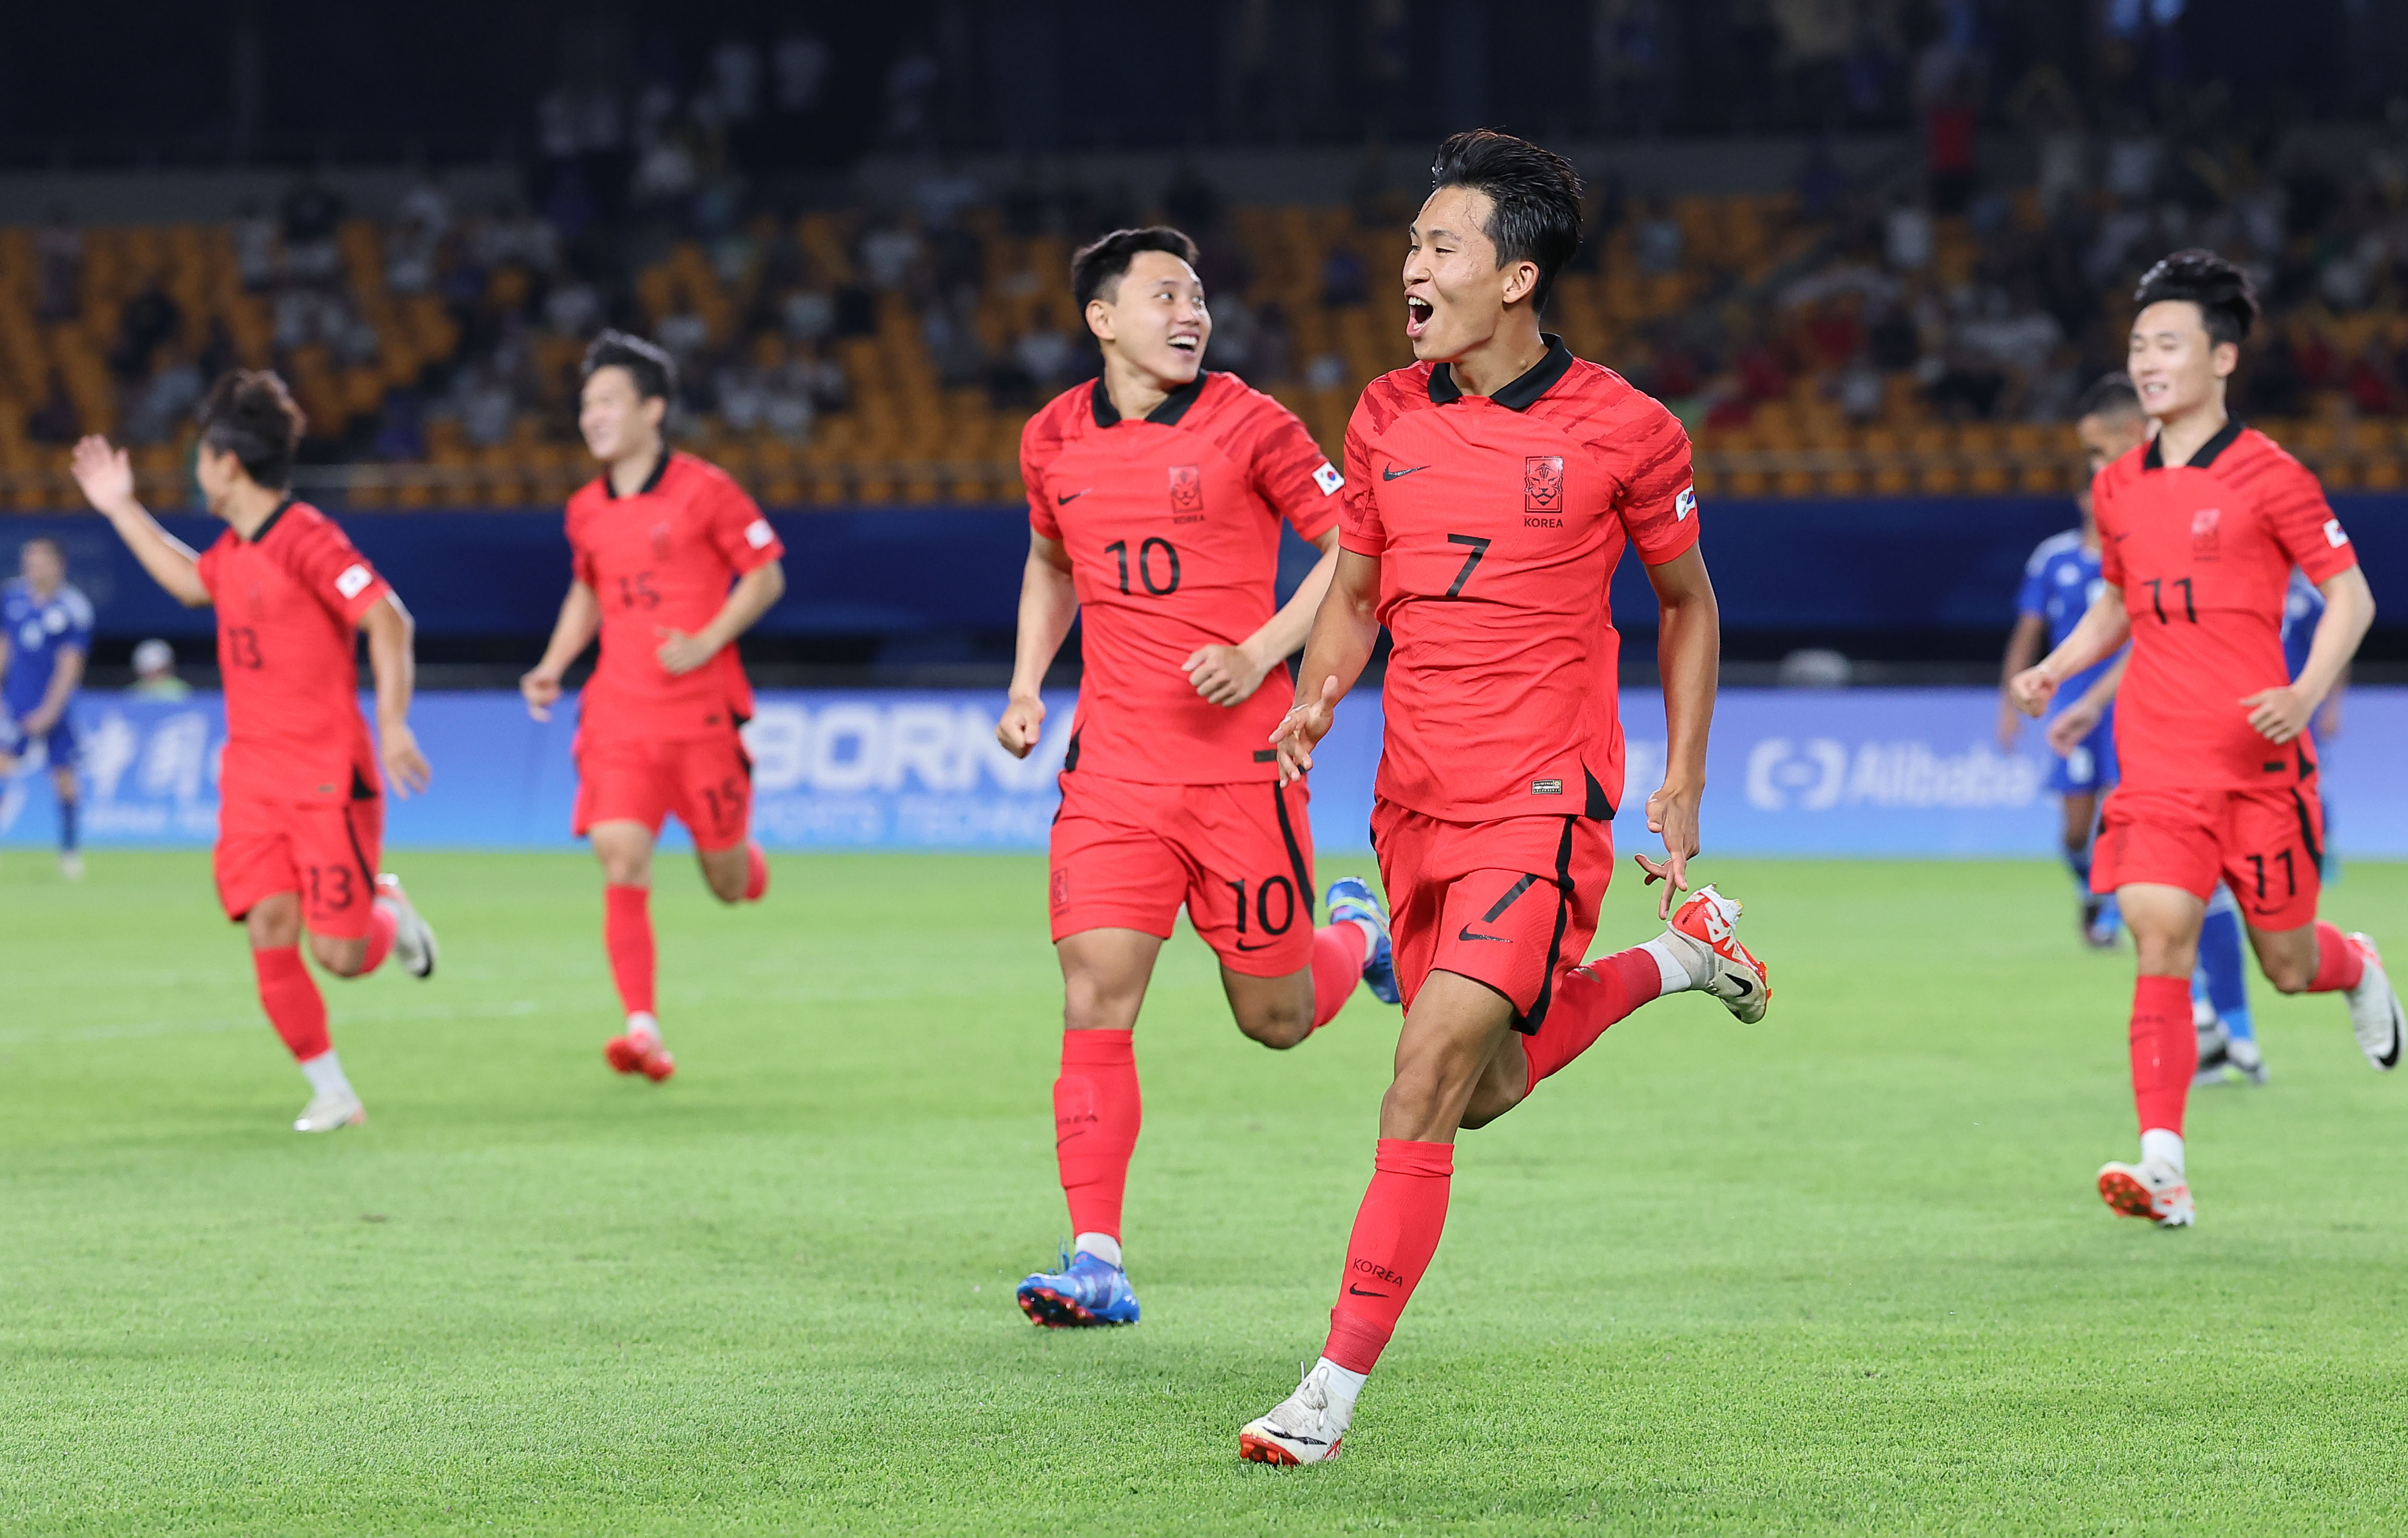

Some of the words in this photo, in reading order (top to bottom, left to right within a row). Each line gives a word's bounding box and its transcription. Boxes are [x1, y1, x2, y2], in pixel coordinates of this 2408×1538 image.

[1524, 518, 1563, 528] KOREA
[1105, 536, 1181, 595] 10
[1445, 533, 1492, 598] 7
[618, 571, 661, 609] 15
[2142, 576, 2197, 625] 11
[228, 625, 264, 670] 13
[704, 775, 746, 822] 15
[307, 864, 353, 911] 13
[2245, 848, 2295, 899] 11
[1226, 875, 1294, 935] 10
[1353, 1257, 1403, 1288] KOREA
